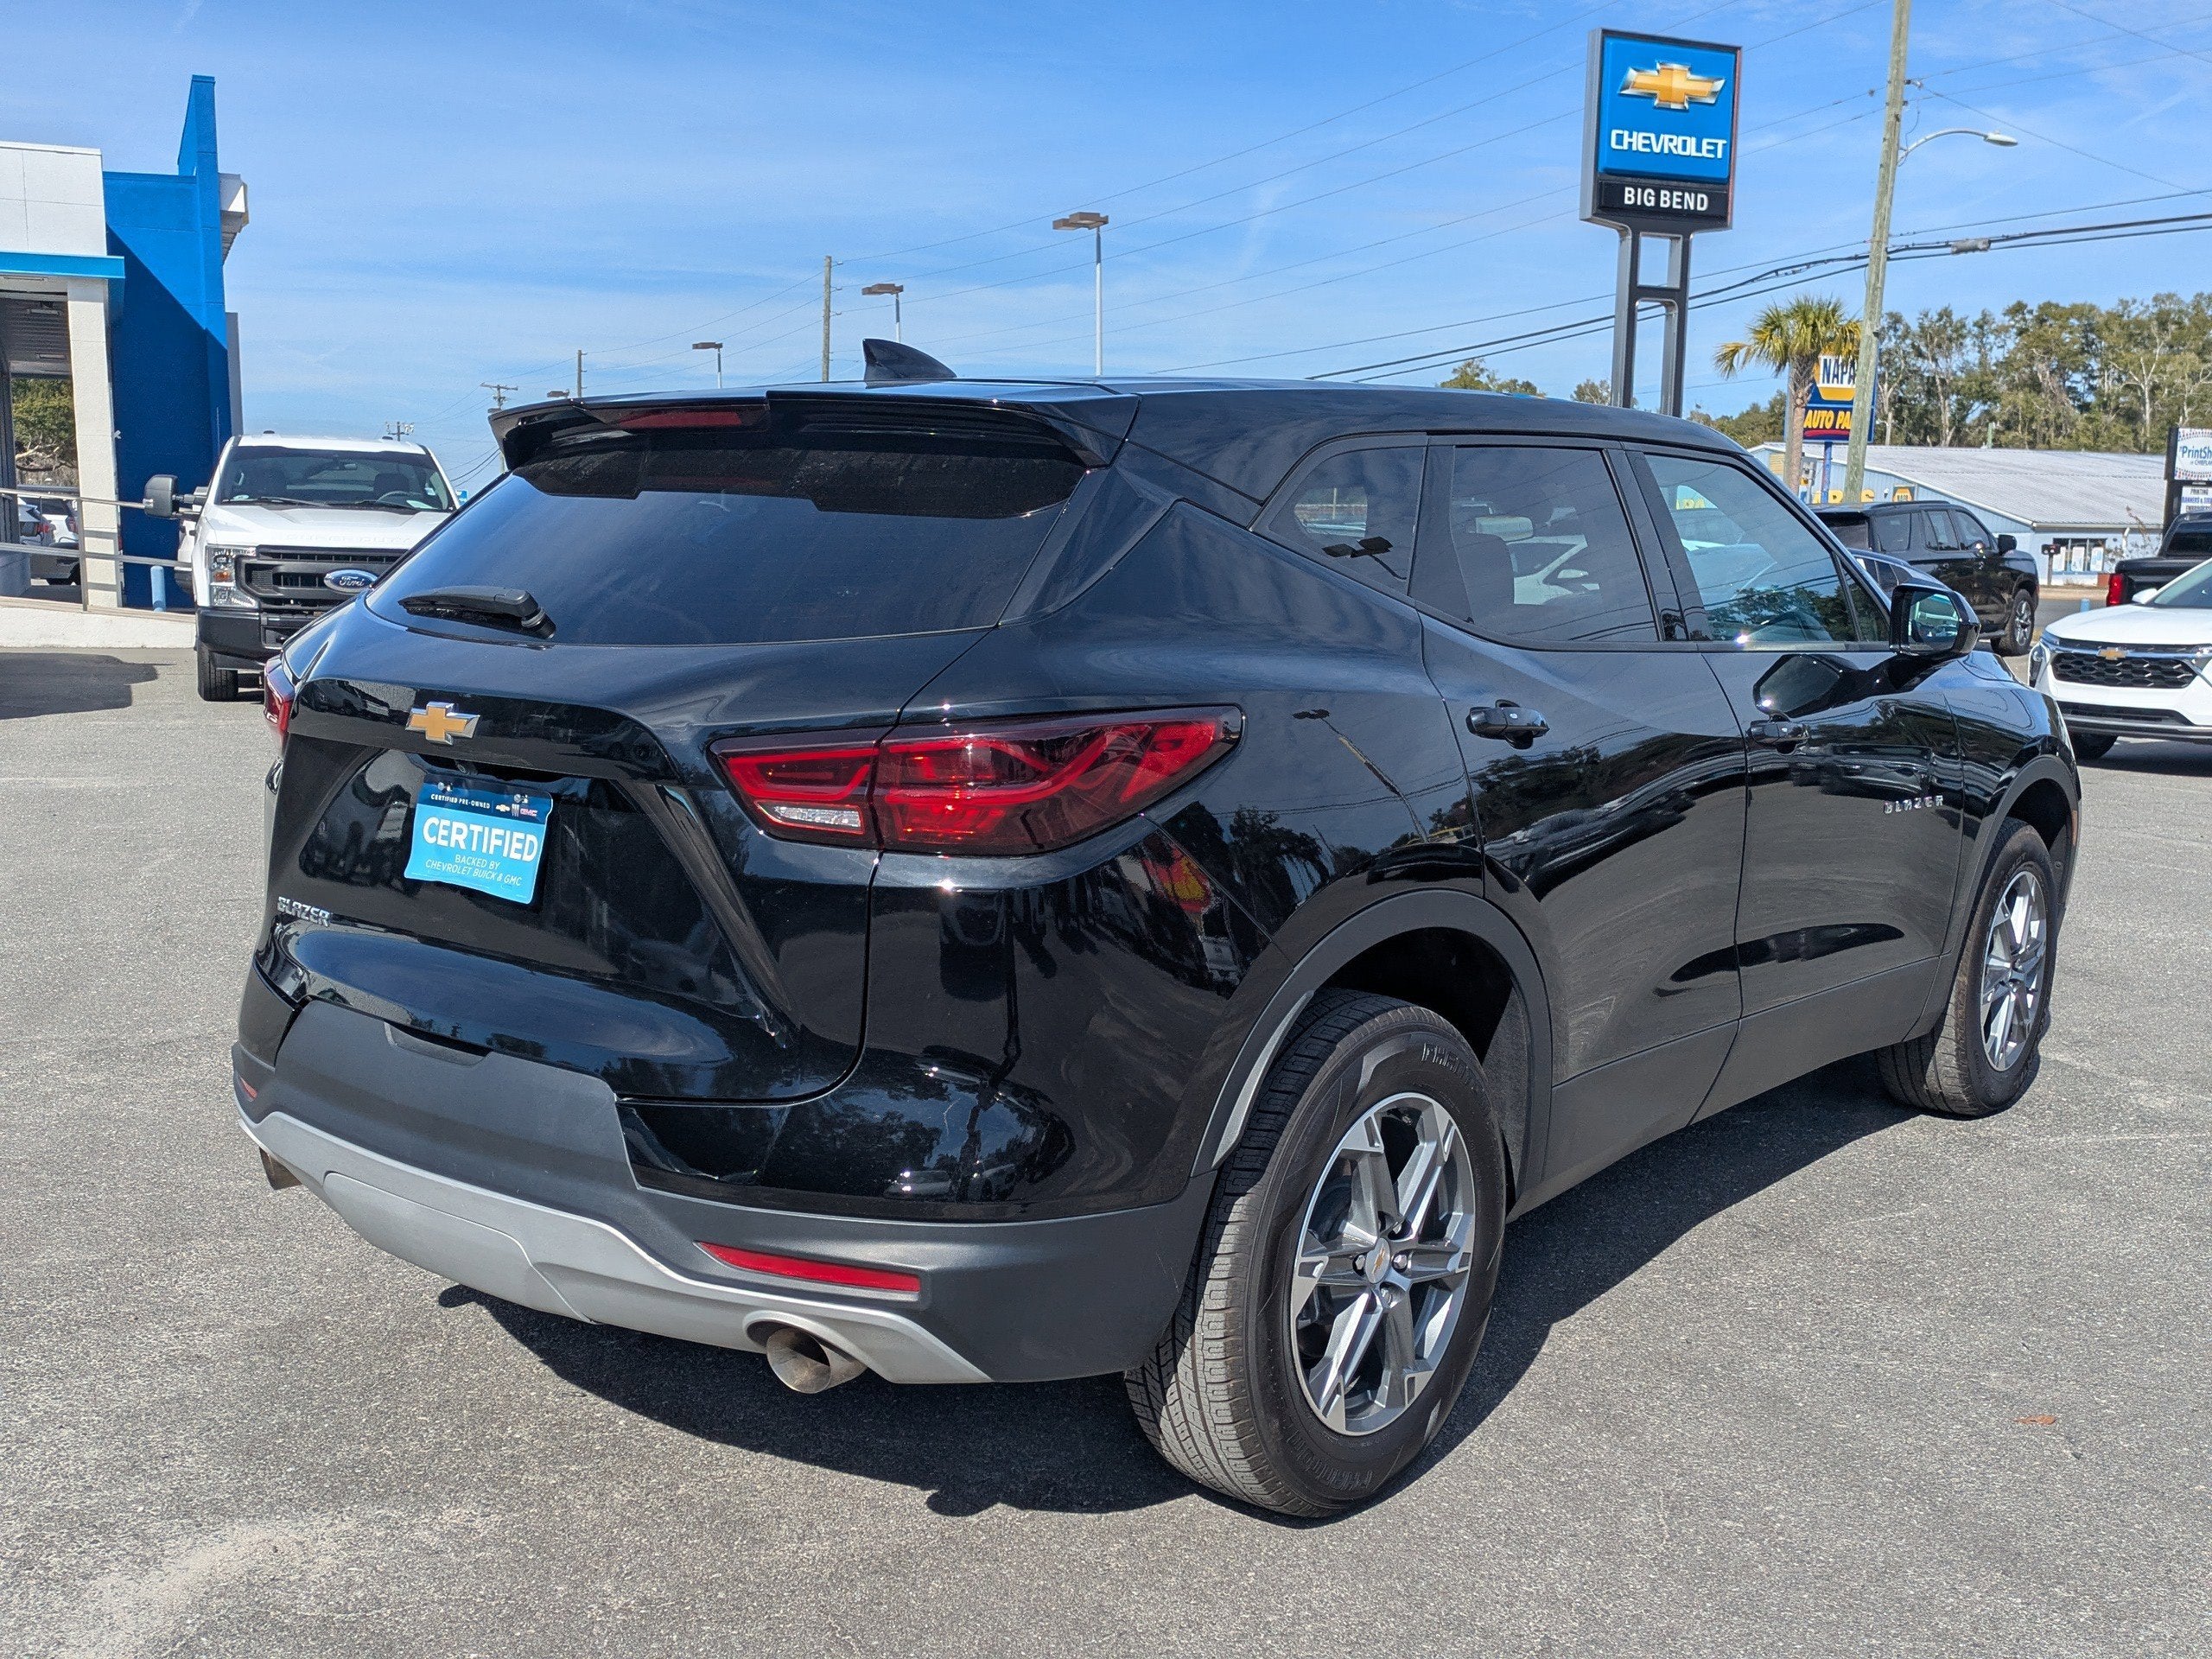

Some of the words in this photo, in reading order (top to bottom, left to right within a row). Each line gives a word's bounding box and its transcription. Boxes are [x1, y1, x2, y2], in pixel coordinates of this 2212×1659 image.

[1611, 129, 1727, 159] CHEVROLET
[1624, 187, 1656, 207] BIG
[1659, 189, 1708, 211] BEND
[1822, 357, 1856, 385] NAPA
[1803, 410, 1835, 429] AUTO
[1835, 410, 1852, 430] PA
[339, 575, 365, 587] Ford
[430, 793, 458, 804] CERTIFIED
[458, 798, 491, 810] PRE-OWNED
[1884, 795, 1944, 814] BLAZER
[423, 817, 538, 862] CERTIFIED
[425, 859, 471, 875] CHEVROLET
[473, 868, 497, 880] BUICK
[504, 874, 523, 887] GMC
[454, 855, 487, 868] BACKED
[489, 861, 501, 870] BY
[277, 896, 329, 927] BLAZER
